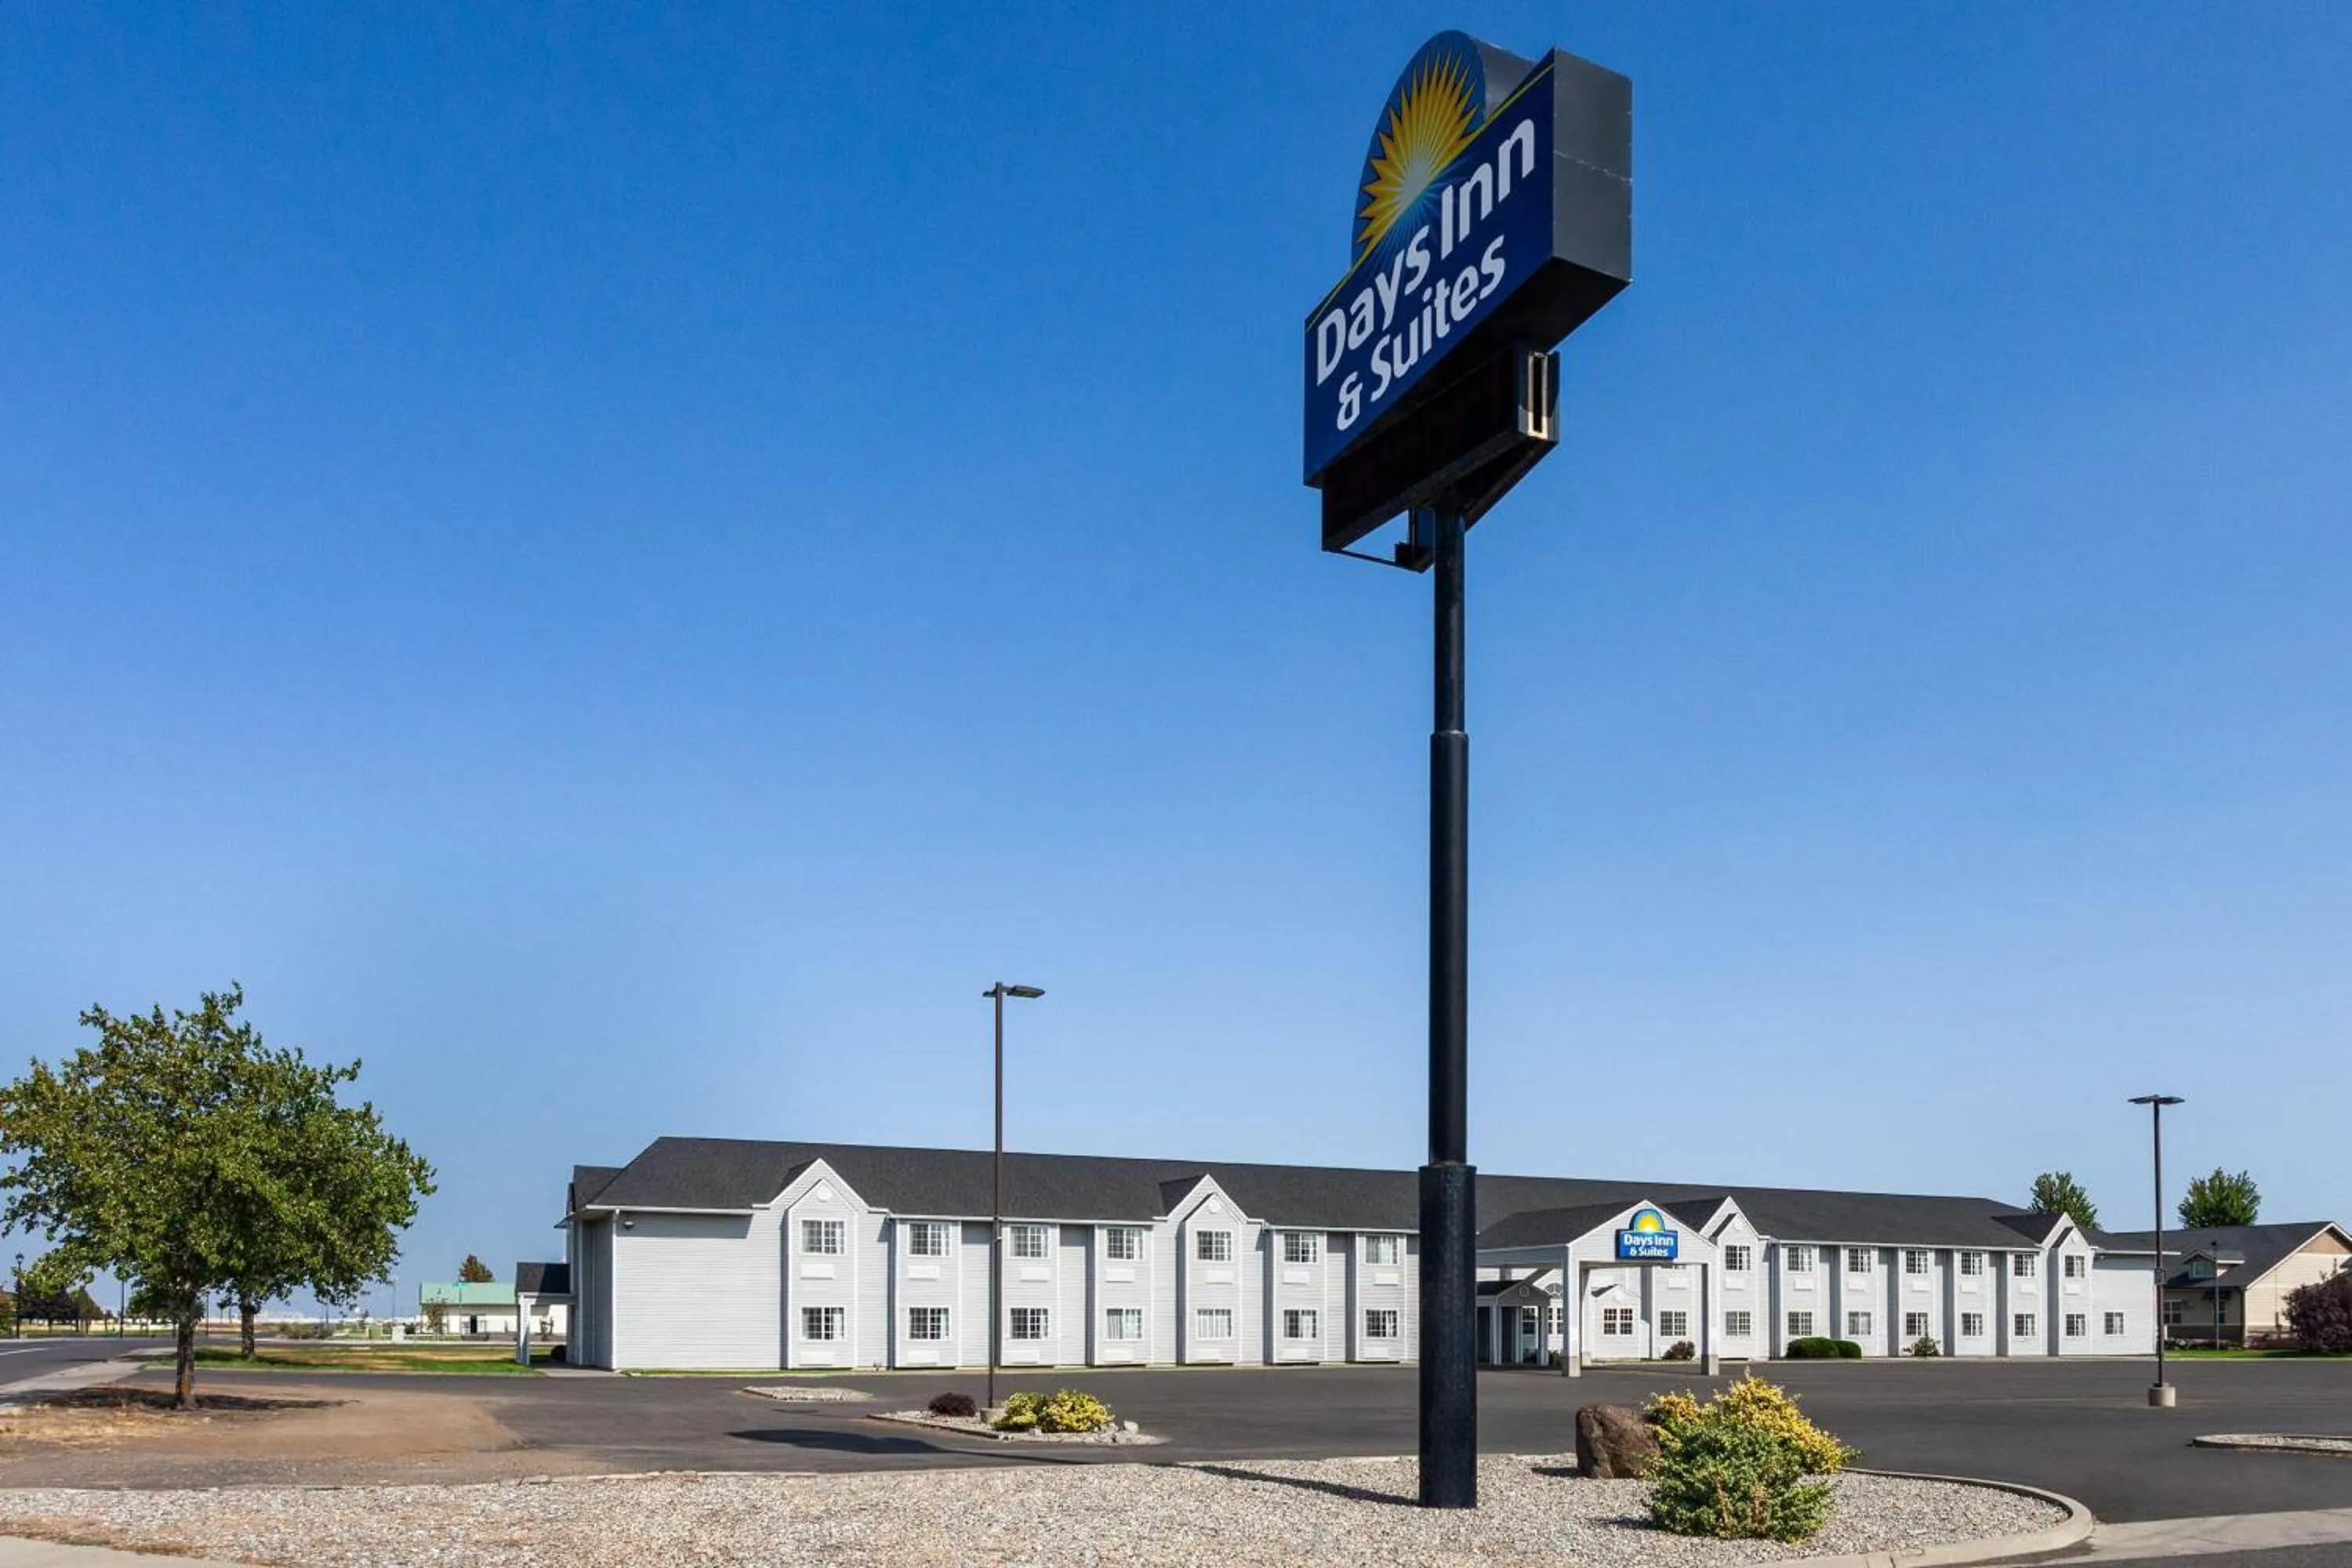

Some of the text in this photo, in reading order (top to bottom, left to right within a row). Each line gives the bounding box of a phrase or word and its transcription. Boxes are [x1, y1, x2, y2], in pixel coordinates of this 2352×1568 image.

[1316, 118, 1536, 387] Days Inn
[1337, 234, 1505, 431] & Suites
[1624, 1233, 1674, 1247] Days Inn
[1639, 1246, 1668, 1257] Suites
